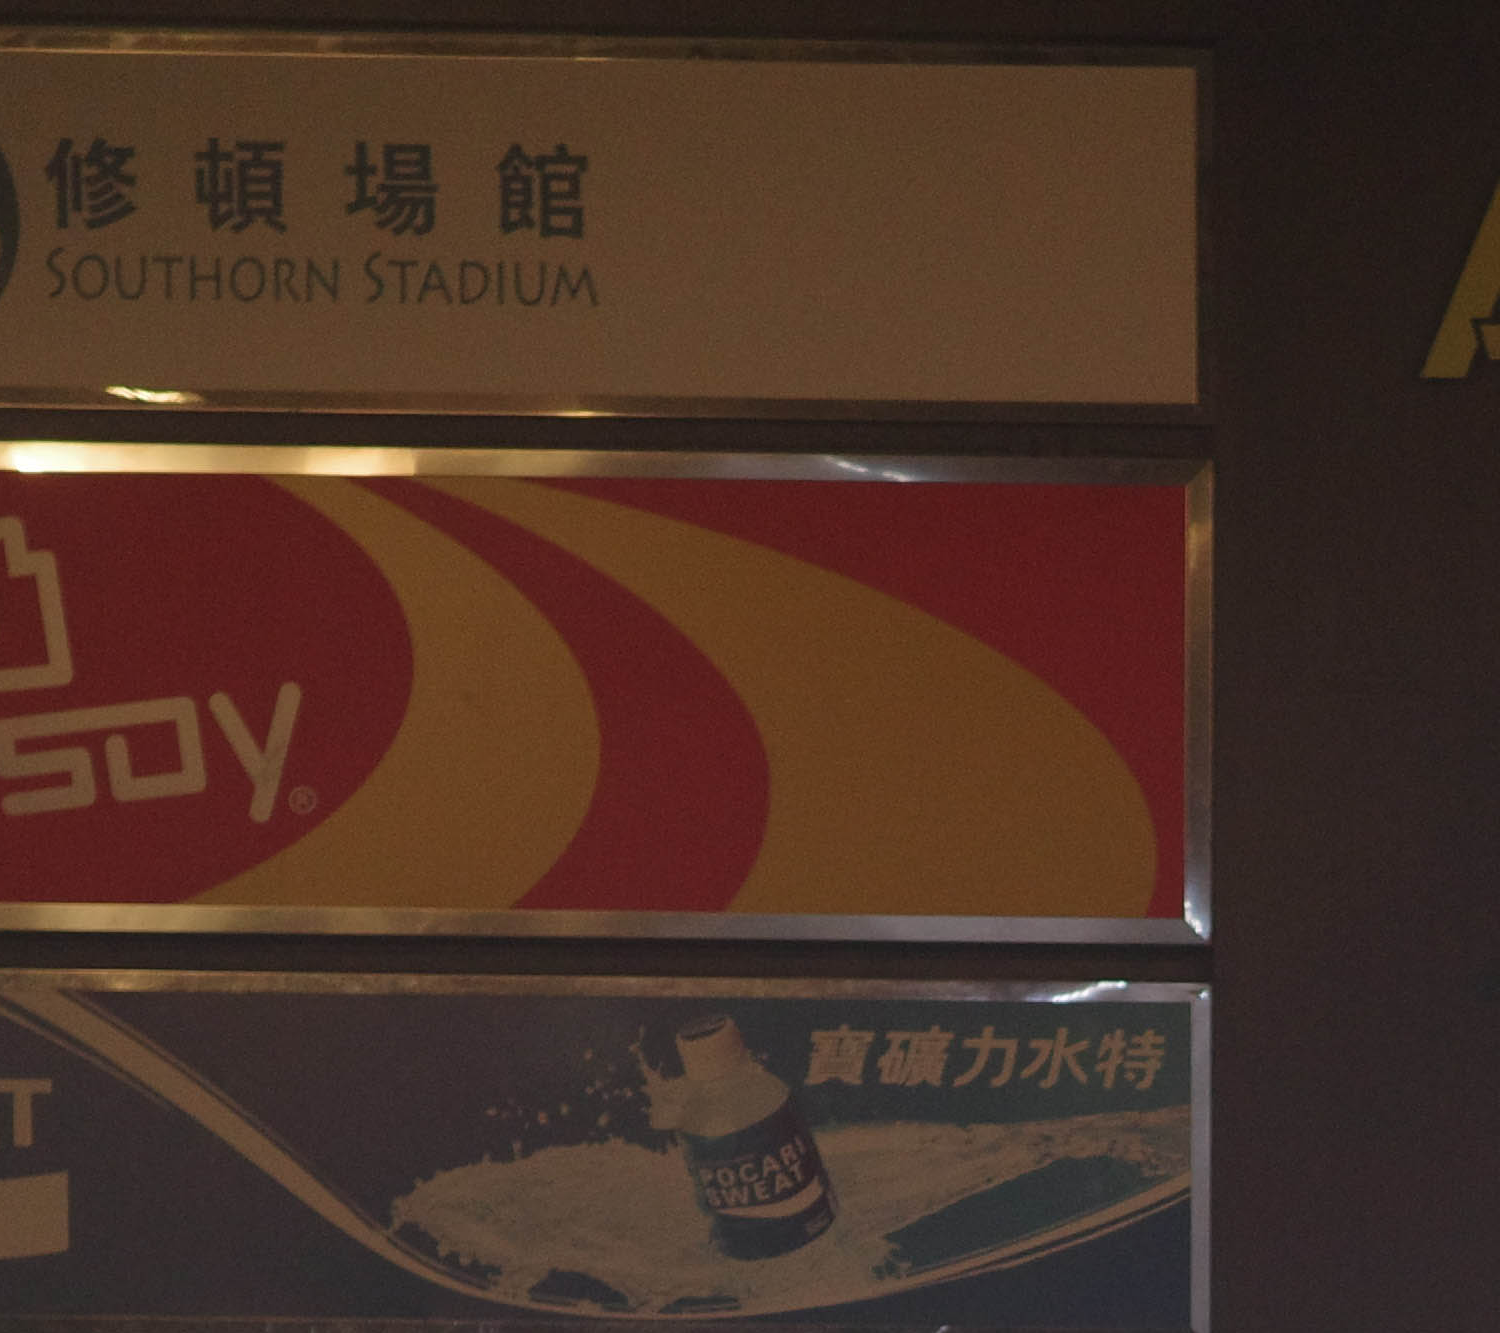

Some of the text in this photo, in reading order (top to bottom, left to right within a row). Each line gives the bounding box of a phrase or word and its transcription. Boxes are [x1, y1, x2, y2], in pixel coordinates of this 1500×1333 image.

[45, 137, 588, 238] 修頓場館
[45, 246, 601, 307] SOUTHORN STADIUM
[804, 1024, 1166, 1089] 寶礦力水特
[701, 1136, 805, 1187] POCARI
[705, 1162, 804, 1208] SWEAT
